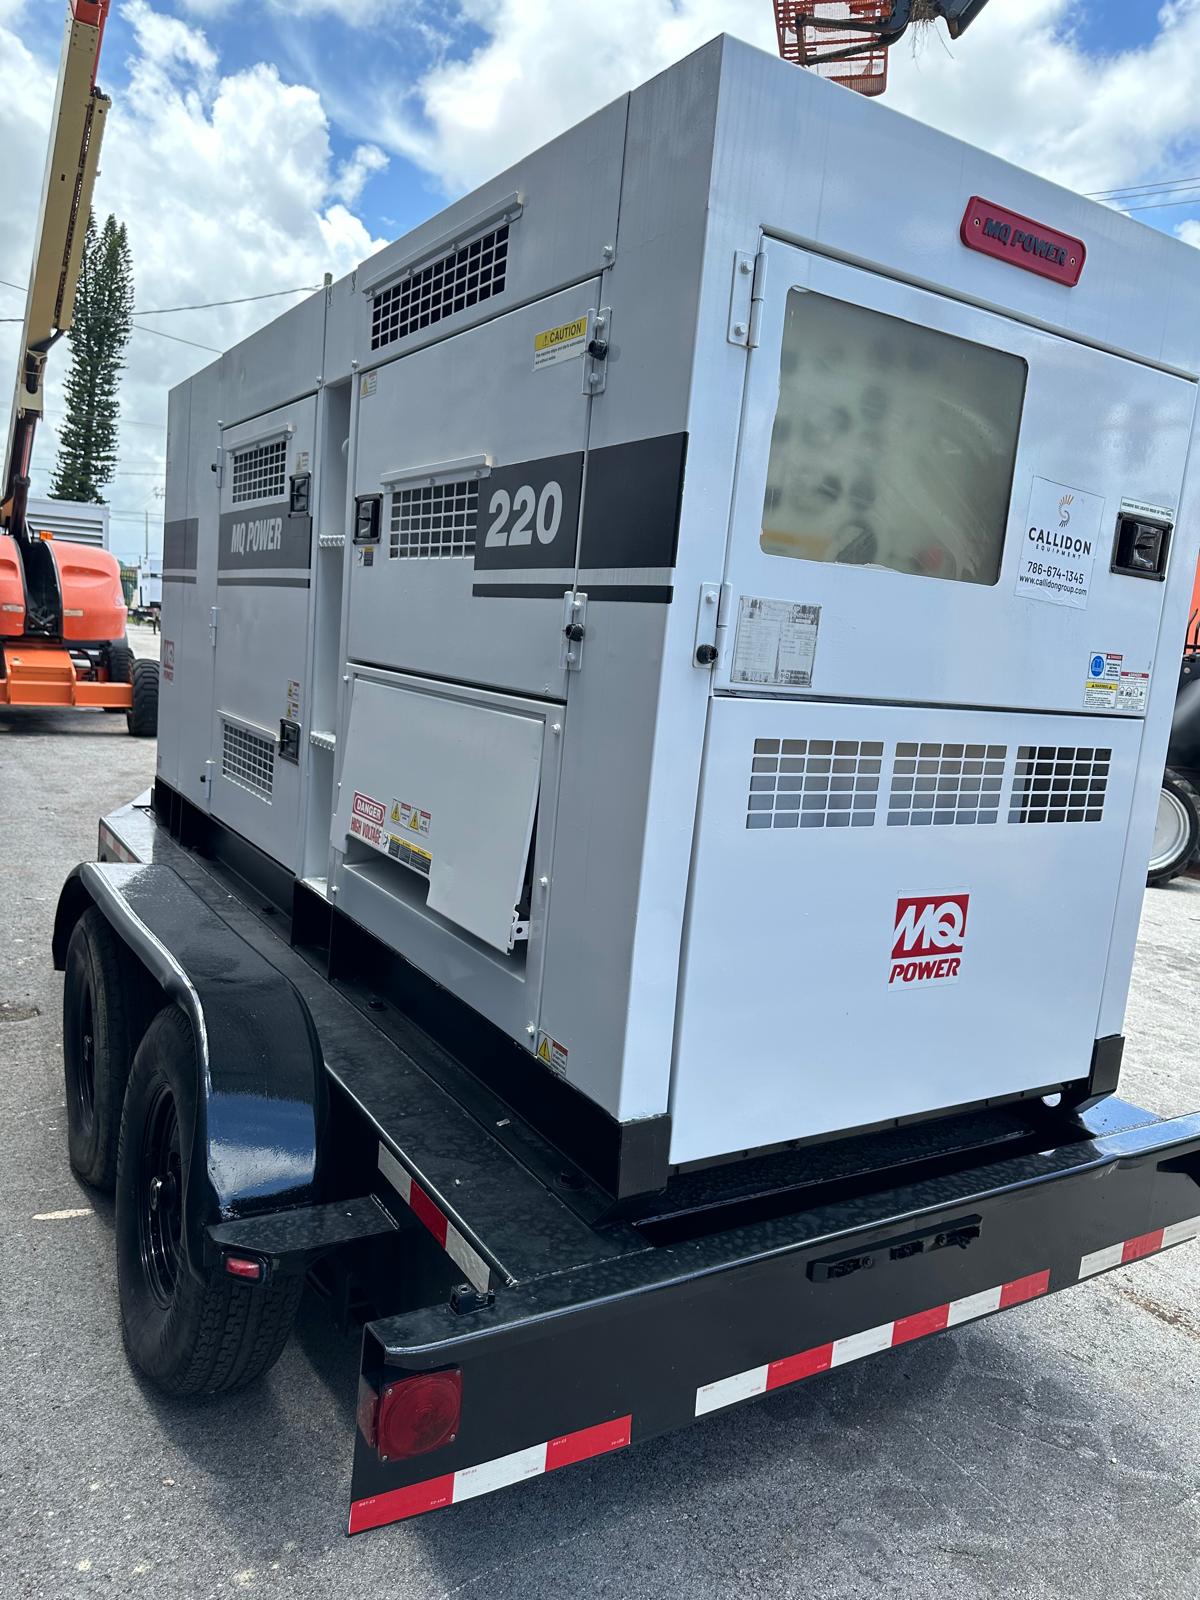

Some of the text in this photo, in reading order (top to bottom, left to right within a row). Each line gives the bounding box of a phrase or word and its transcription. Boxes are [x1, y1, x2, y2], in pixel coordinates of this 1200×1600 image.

[983, 217, 1068, 267] MQ POWER
[550, 322, 582, 343] CAUTION
[485, 481, 563, 548] 220
[231, 517, 282, 556] MQ POWER
[1028, 527, 1092, 556] CALLIDON
[1035, 543, 1082, 560] EQUIPMENT
[1019, 575, 1088, 596] www.callidongroup.com
[1027, 561, 1085, 585] 786-674-1345
[356, 798, 382, 820] DANGER
[892, 899, 966, 952] MQ
[888, 957, 962, 984] POWER
